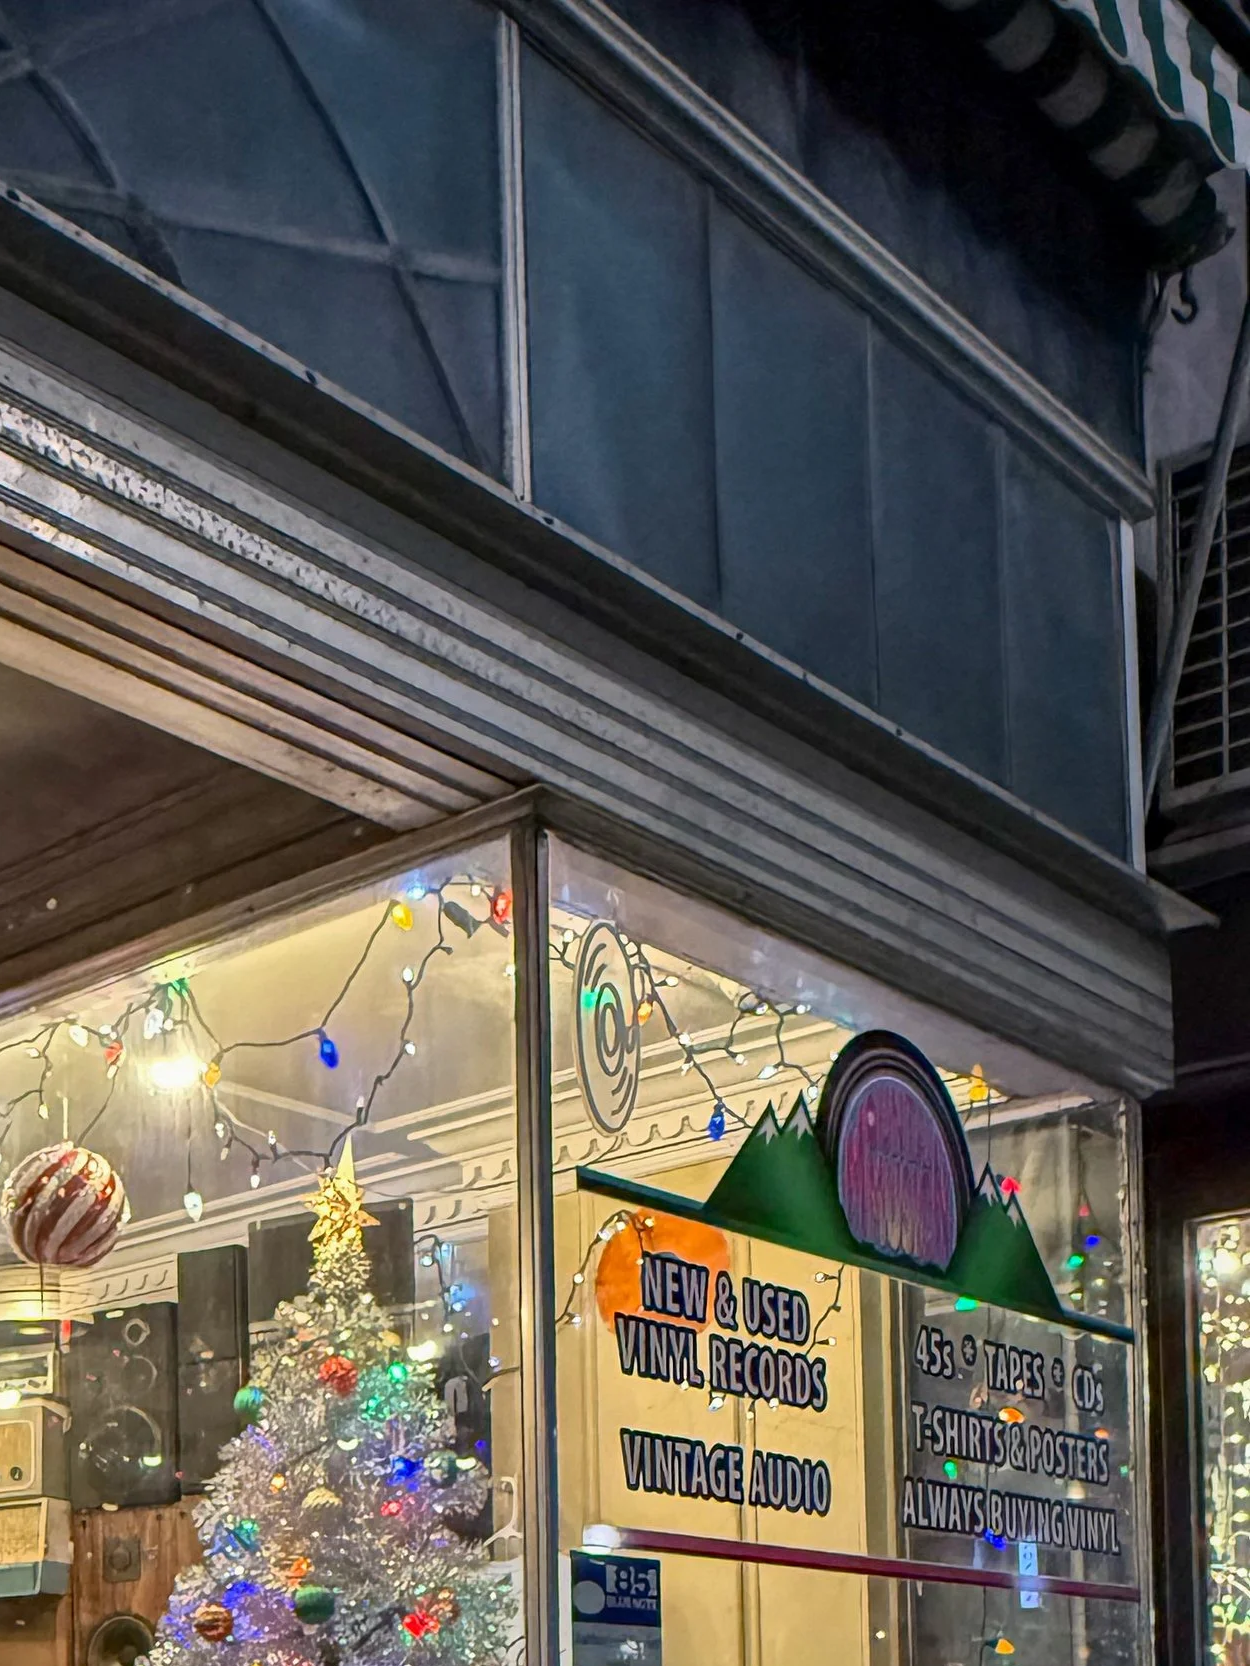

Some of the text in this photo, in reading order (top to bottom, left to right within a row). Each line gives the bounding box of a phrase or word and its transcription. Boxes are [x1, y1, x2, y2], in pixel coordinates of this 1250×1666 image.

[643, 1254, 809, 1344] NEW & USED
[616, 1314, 826, 1411] VINYL RECORDS
[916, 1326, 1103, 1414] 45s TAPES CDs
[621, 1430, 830, 1515] VINTAGE AUDIO
[911, 1403, 1108, 1485] T-SHIRTS & POSTERS
[903, 1477, 1120, 1554] ALWAYS BUYING VINYL
